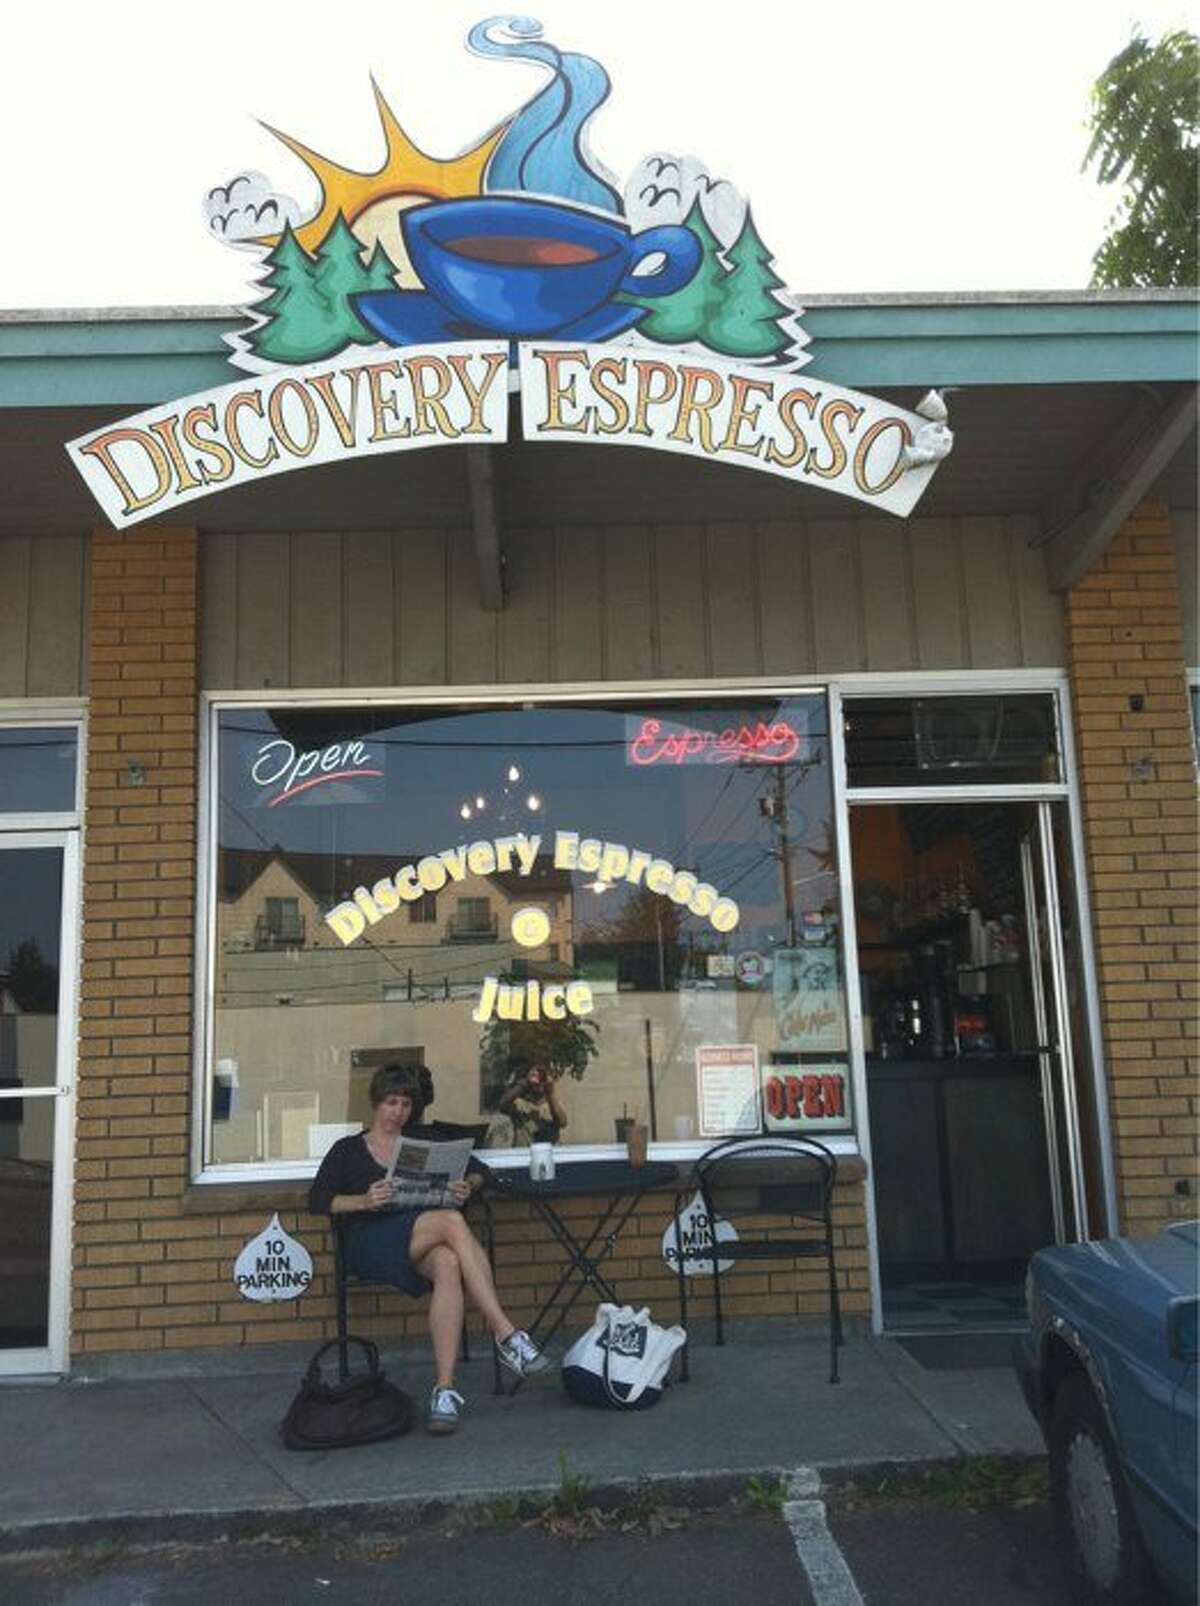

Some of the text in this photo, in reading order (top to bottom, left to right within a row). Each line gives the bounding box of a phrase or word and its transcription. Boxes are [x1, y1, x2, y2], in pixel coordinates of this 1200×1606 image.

[79, 350, 913, 515] DISCOVERY ESPRESSO
[629, 718, 800, 765] Espresso
[251, 739, 371, 792] Open
[324, 830, 740, 946] Discovery Espresso
[472, 976, 595, 1022] Juice
[766, 1074, 845, 1120] OPEN
[265, 1240, 285, 1255] 10
[683, 1231, 713, 1246] MIN
[237, 1270, 310, 1290] PARKING
[256, 1256, 290, 1273] MIN
